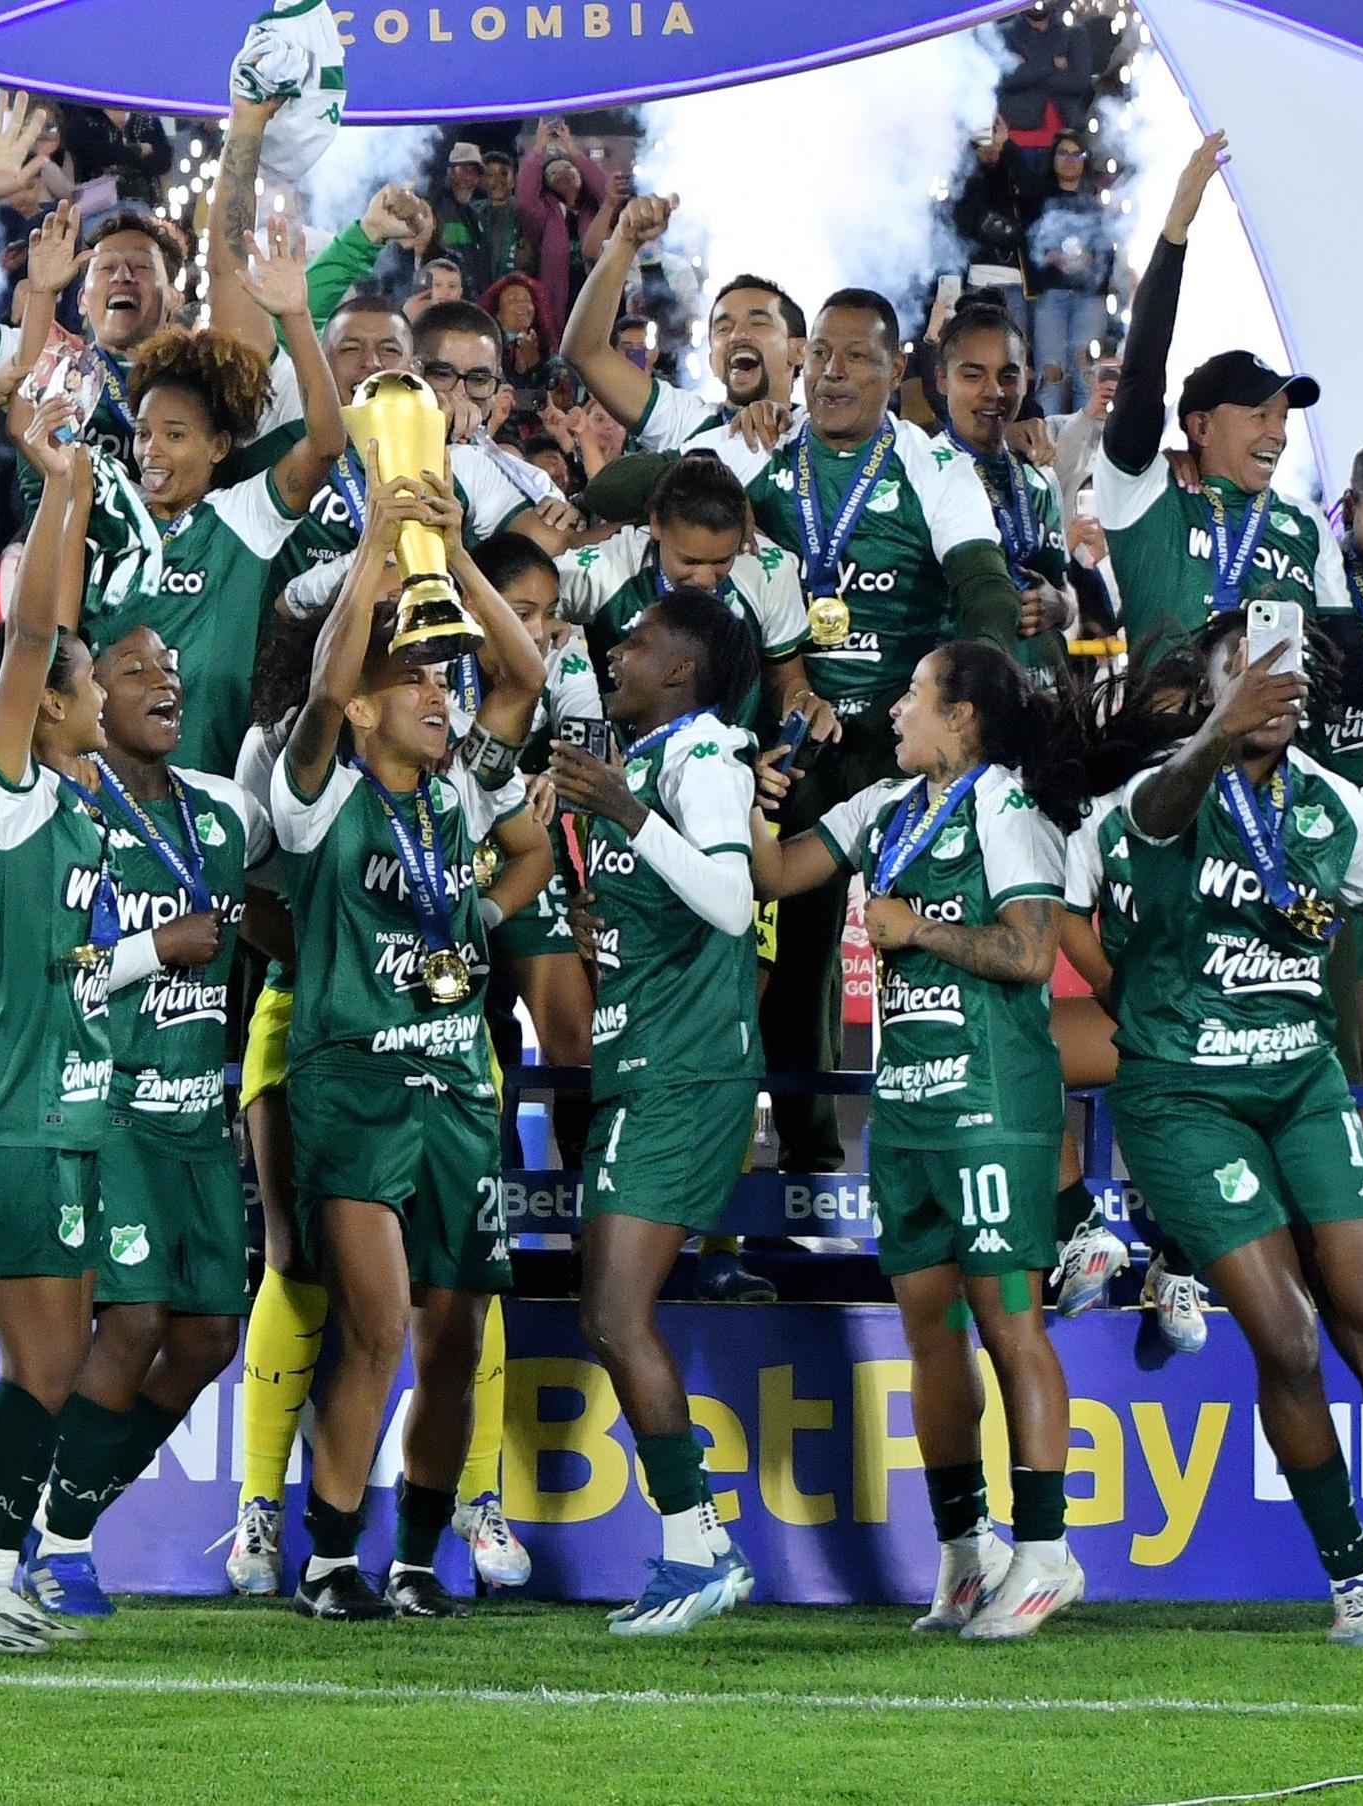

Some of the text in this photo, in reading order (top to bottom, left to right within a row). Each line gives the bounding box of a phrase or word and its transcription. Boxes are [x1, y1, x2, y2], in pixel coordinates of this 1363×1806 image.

[337, 2, 695, 45] COLOMBIA
[824, 432, 895, 568] LIGA FEMENINA BetPlay
[801, 497, 821, 555] DIMAYOR
[1225, 560, 1243, 585] LIGA
[375, 932, 415, 945] PASTAS
[1206, 932, 1269, 957] PASTAS La
[1202, 946, 1321, 987] Muñeca
[958, 1163, 1011, 1226] 10
